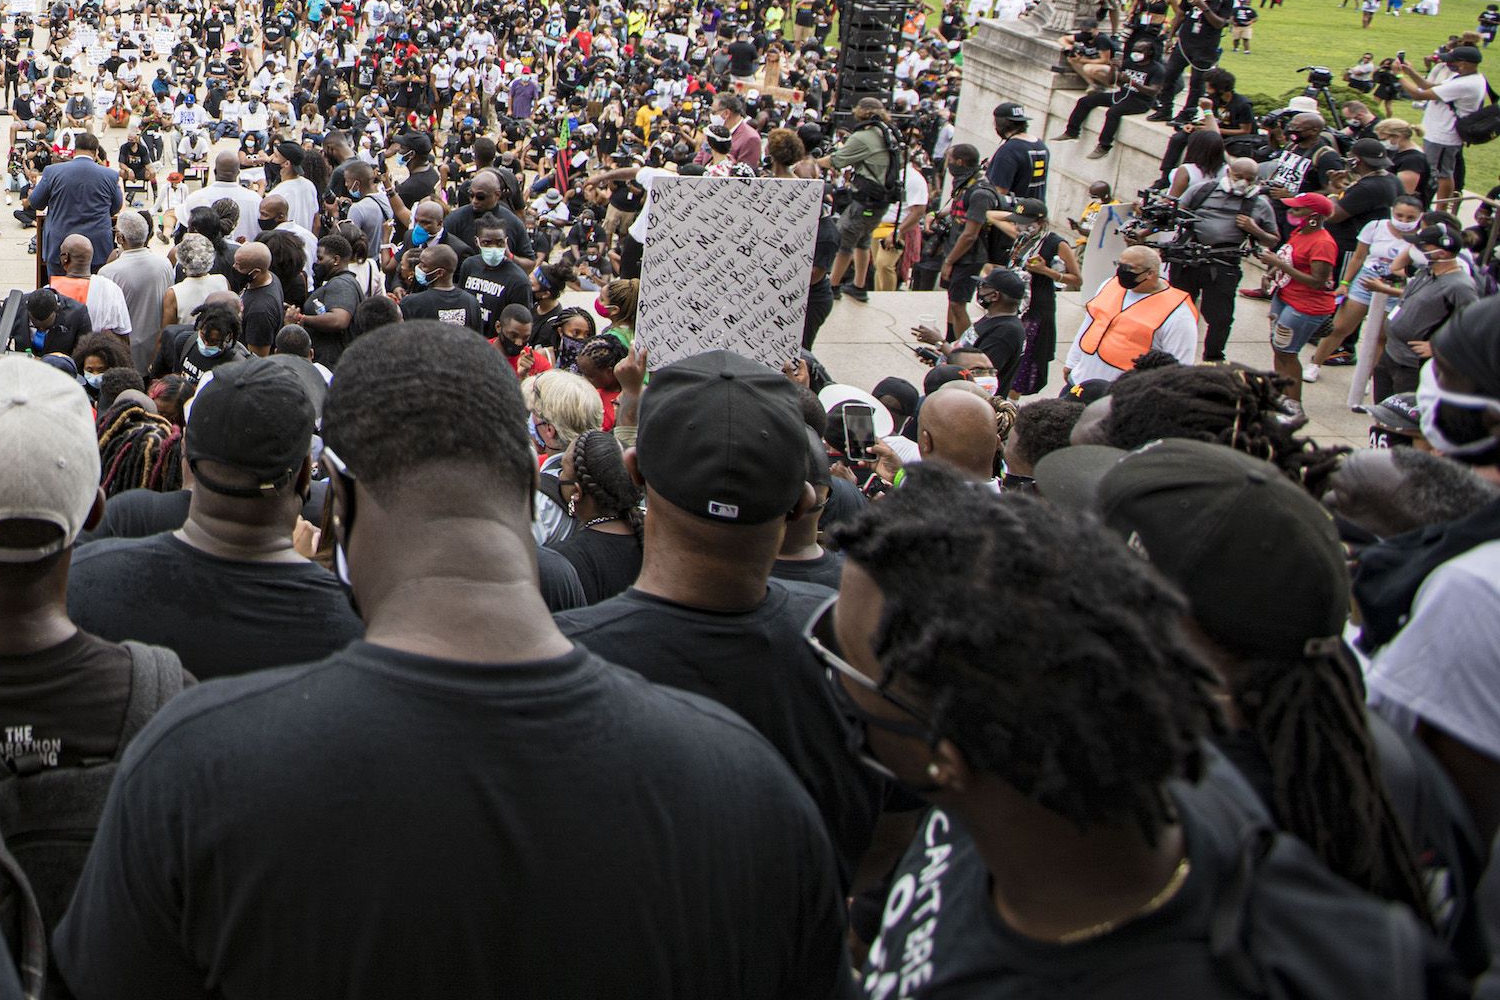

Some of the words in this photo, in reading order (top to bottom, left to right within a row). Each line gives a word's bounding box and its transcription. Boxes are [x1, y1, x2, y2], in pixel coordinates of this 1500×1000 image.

[465, 276, 505, 297] EVERYBODY
[5, 725, 33, 742] THE
[899, 917, 938, 1000] BRE
